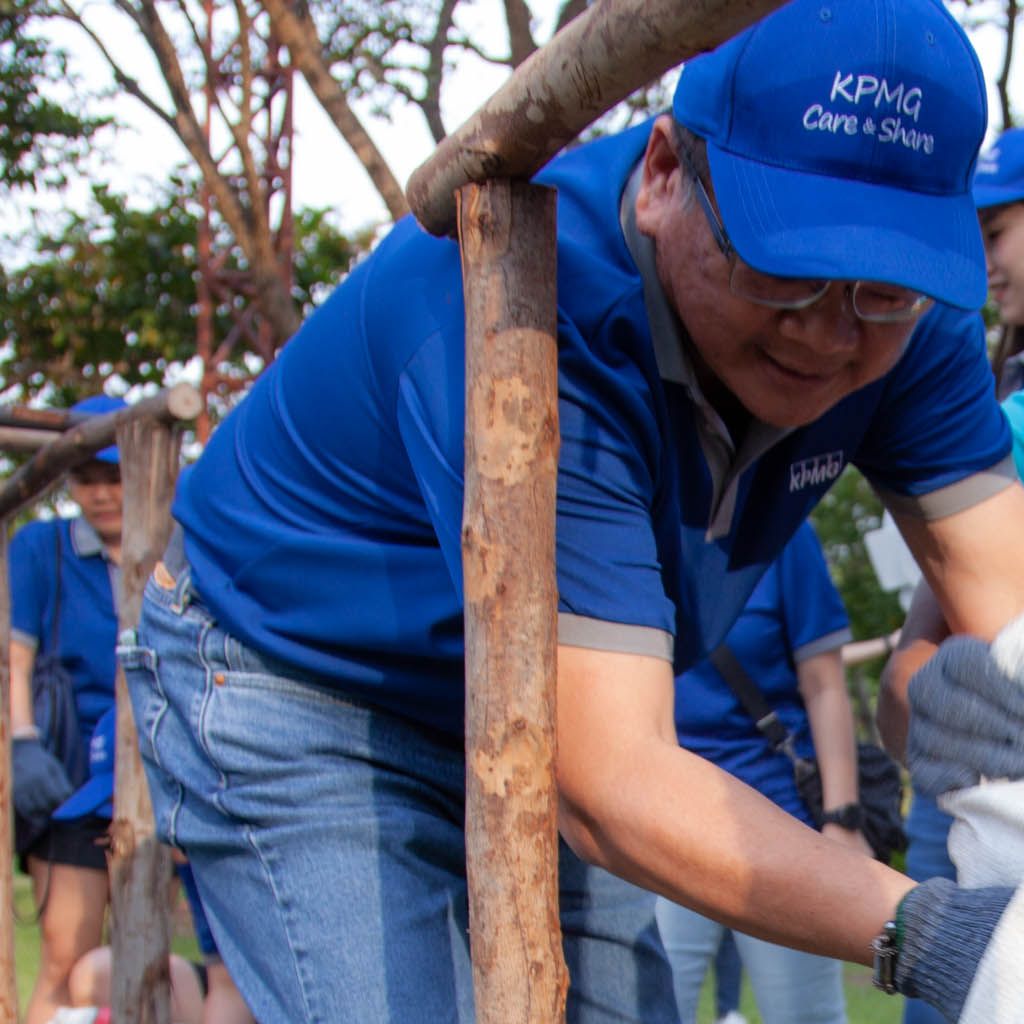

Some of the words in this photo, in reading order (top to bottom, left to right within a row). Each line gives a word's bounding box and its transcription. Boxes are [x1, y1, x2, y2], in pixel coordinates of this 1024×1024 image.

[830, 70, 922, 122] KPMG
[803, 104, 858, 135] Care
[862, 117, 876, 135] &
[878, 117, 934, 154] Share
[789, 459, 840, 493] KPMG
